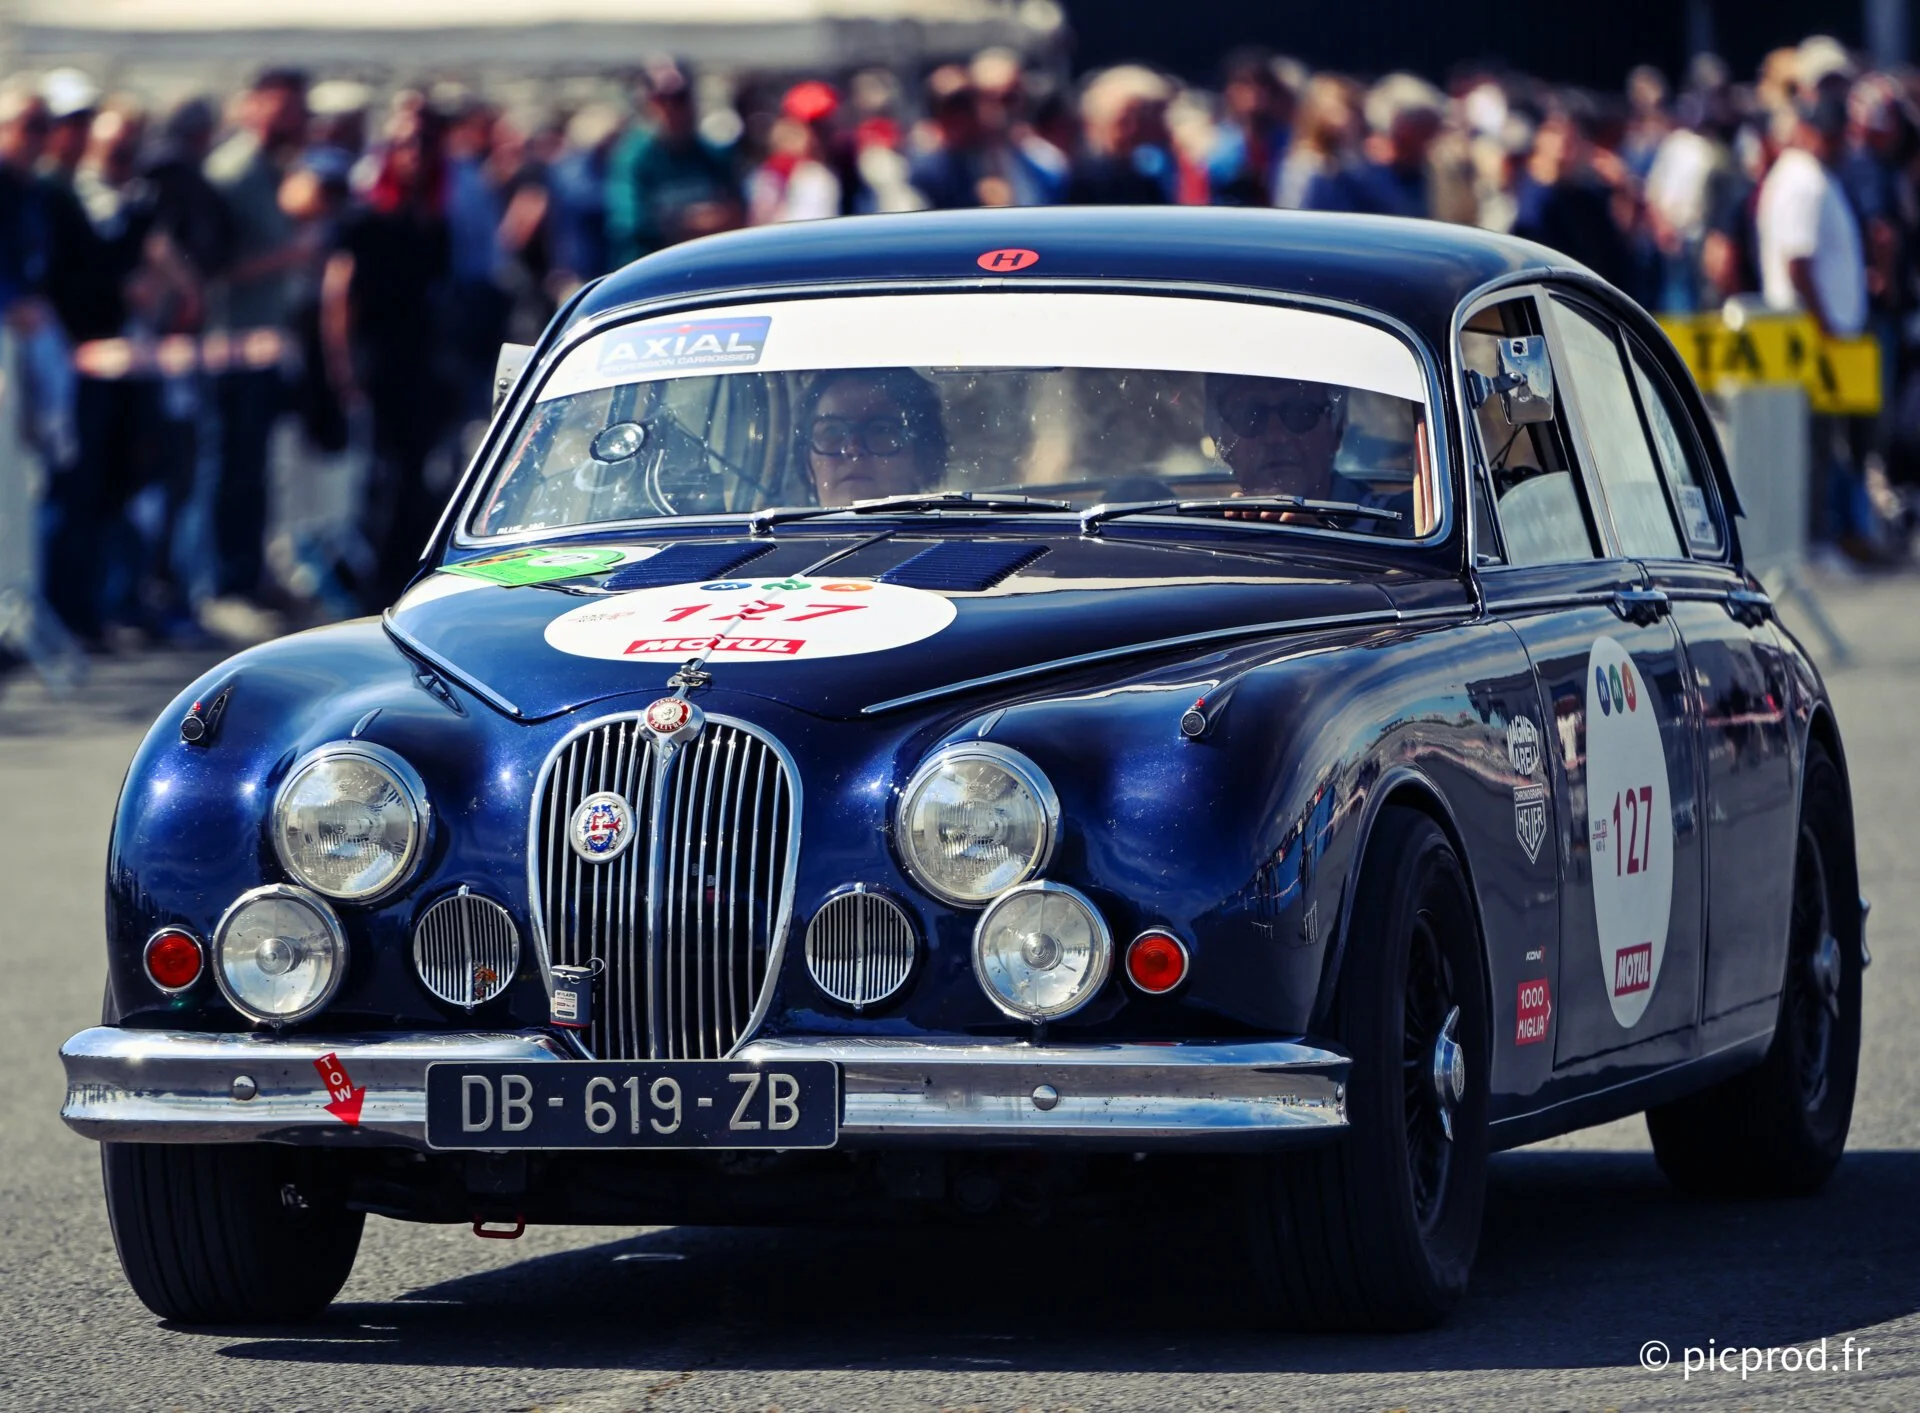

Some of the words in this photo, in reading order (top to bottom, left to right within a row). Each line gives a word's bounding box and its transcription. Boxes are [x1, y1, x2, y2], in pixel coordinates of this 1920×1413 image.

[991, 253, 1024, 267] H
[602, 332, 757, 365] AXIAL
[677, 353, 756, 365] CARROSSIER
[662, 603, 870, 622] 127
[631, 637, 796, 653] MOTUL
[1515, 788, 1543, 802] CHRONOGRAPH
[1518, 806, 1544, 851] HEUER
[1613, 785, 1653, 877] 127
[1616, 950, 1650, 990] MOTUL
[1521, 985, 1544, 1010] 1000
[1517, 1015, 1545, 1040] MIGLIA
[320, 1056, 352, 1103] TOW
